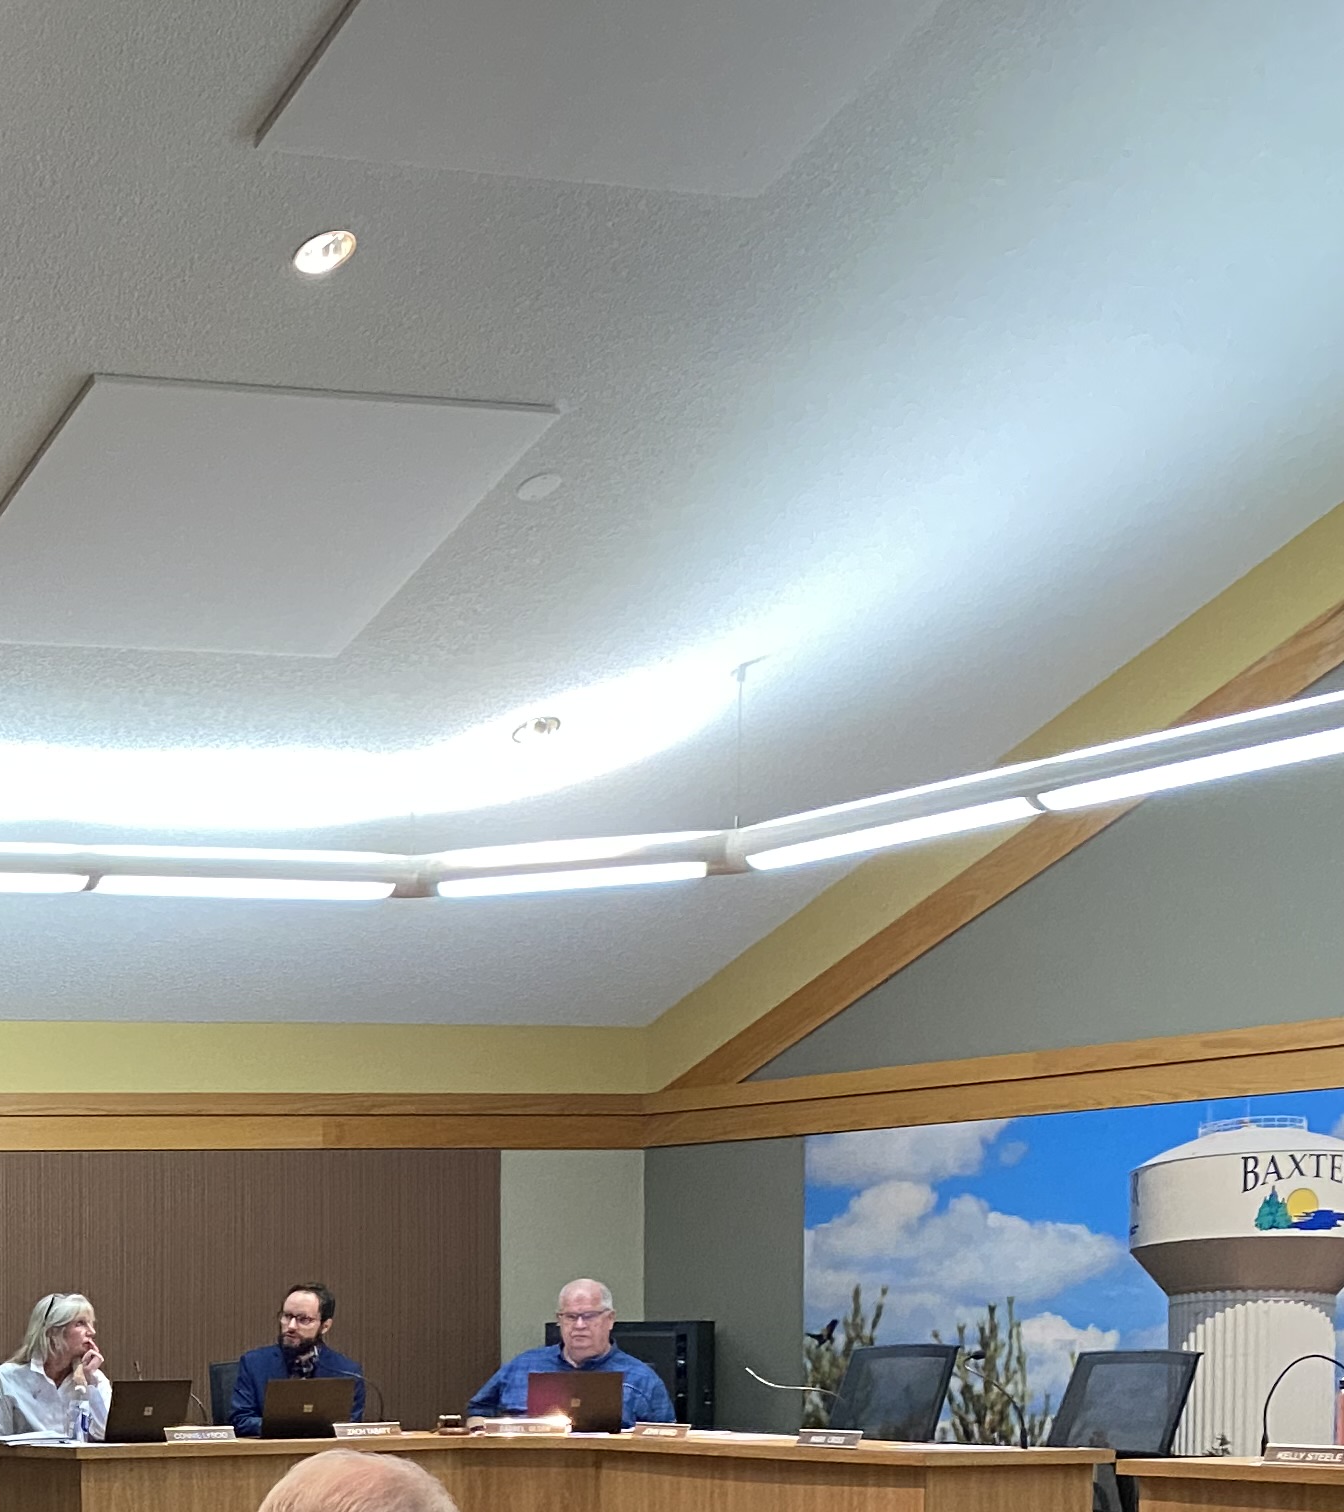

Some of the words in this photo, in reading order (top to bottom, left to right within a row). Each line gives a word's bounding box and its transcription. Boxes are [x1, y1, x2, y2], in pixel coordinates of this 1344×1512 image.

[1241, 1153, 1344, 1193] BAXTE
[1277, 1451, 1306, 1461] KELLY
[1305, 1452, 1344, 1462] STEELE
